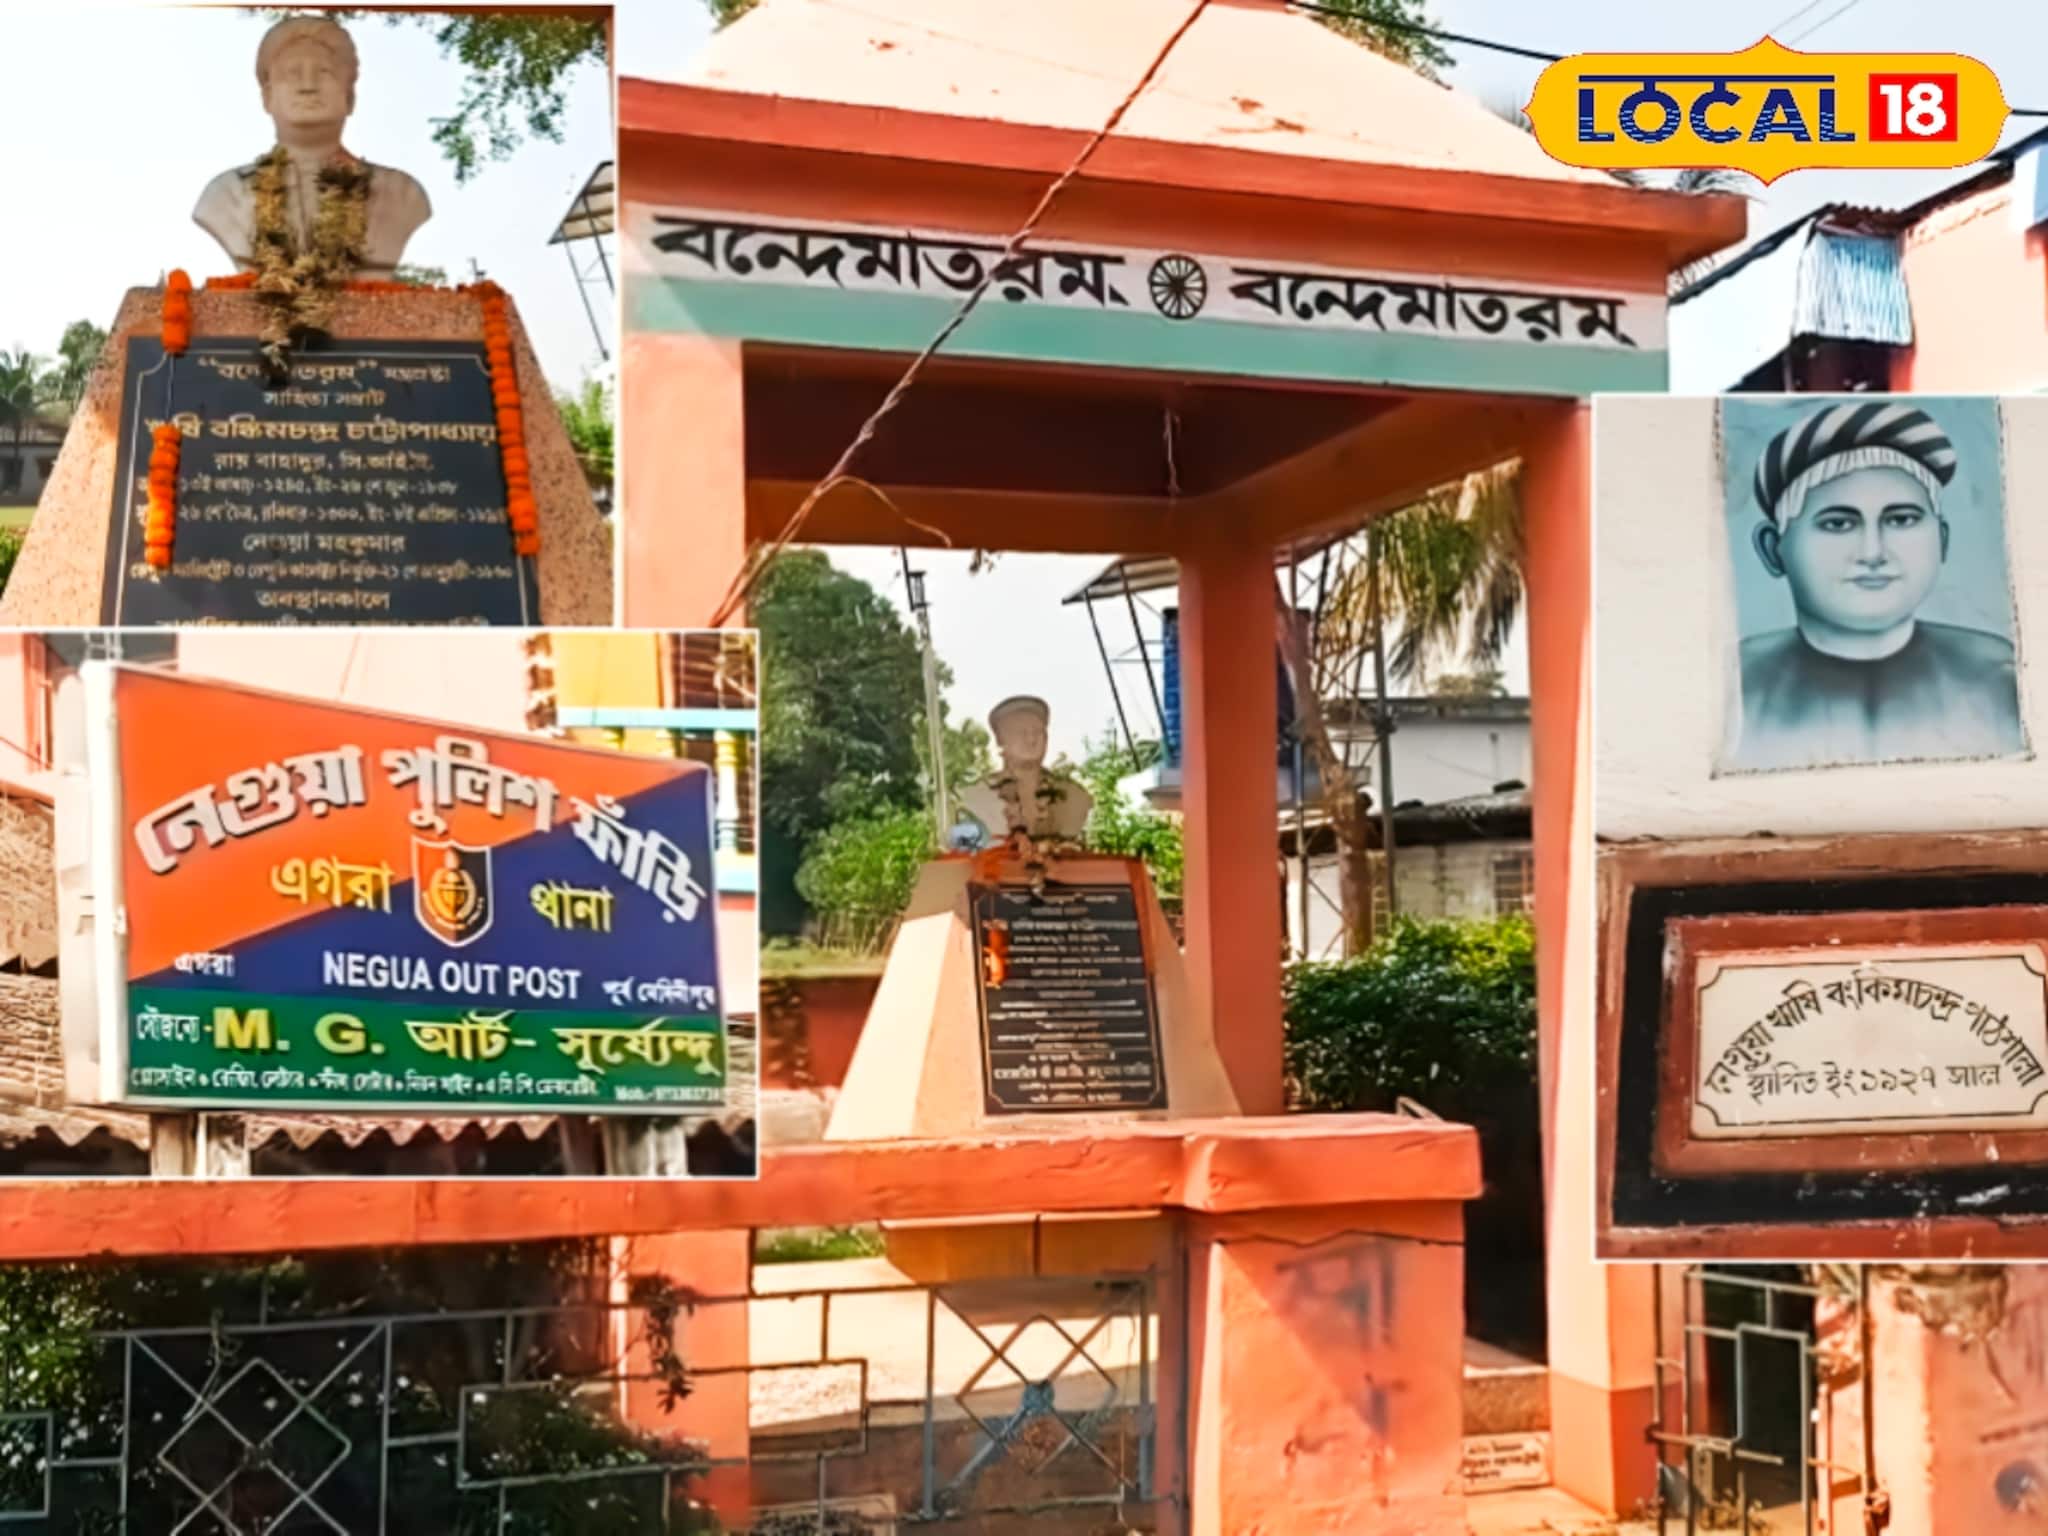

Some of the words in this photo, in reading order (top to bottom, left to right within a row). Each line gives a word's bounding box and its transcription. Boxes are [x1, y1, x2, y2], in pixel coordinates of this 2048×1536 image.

[1229, 267, 1637, 347] বন্দেমাতরম্
[134, 743, 368, 875] নেগুয়া
[380, 735, 560, 835] পুলিশ
[568, 793, 707, 923] ফাঁড়ি
[271, 855, 397, 914] এগরা
[529, 880, 615, 933] থানা
[323, 950, 434, 991] NEGUA
[439, 960, 500, 995] OUT
[507, 965, 582, 1000] POST
[1945, 1063, 2001, 1088] সাল
